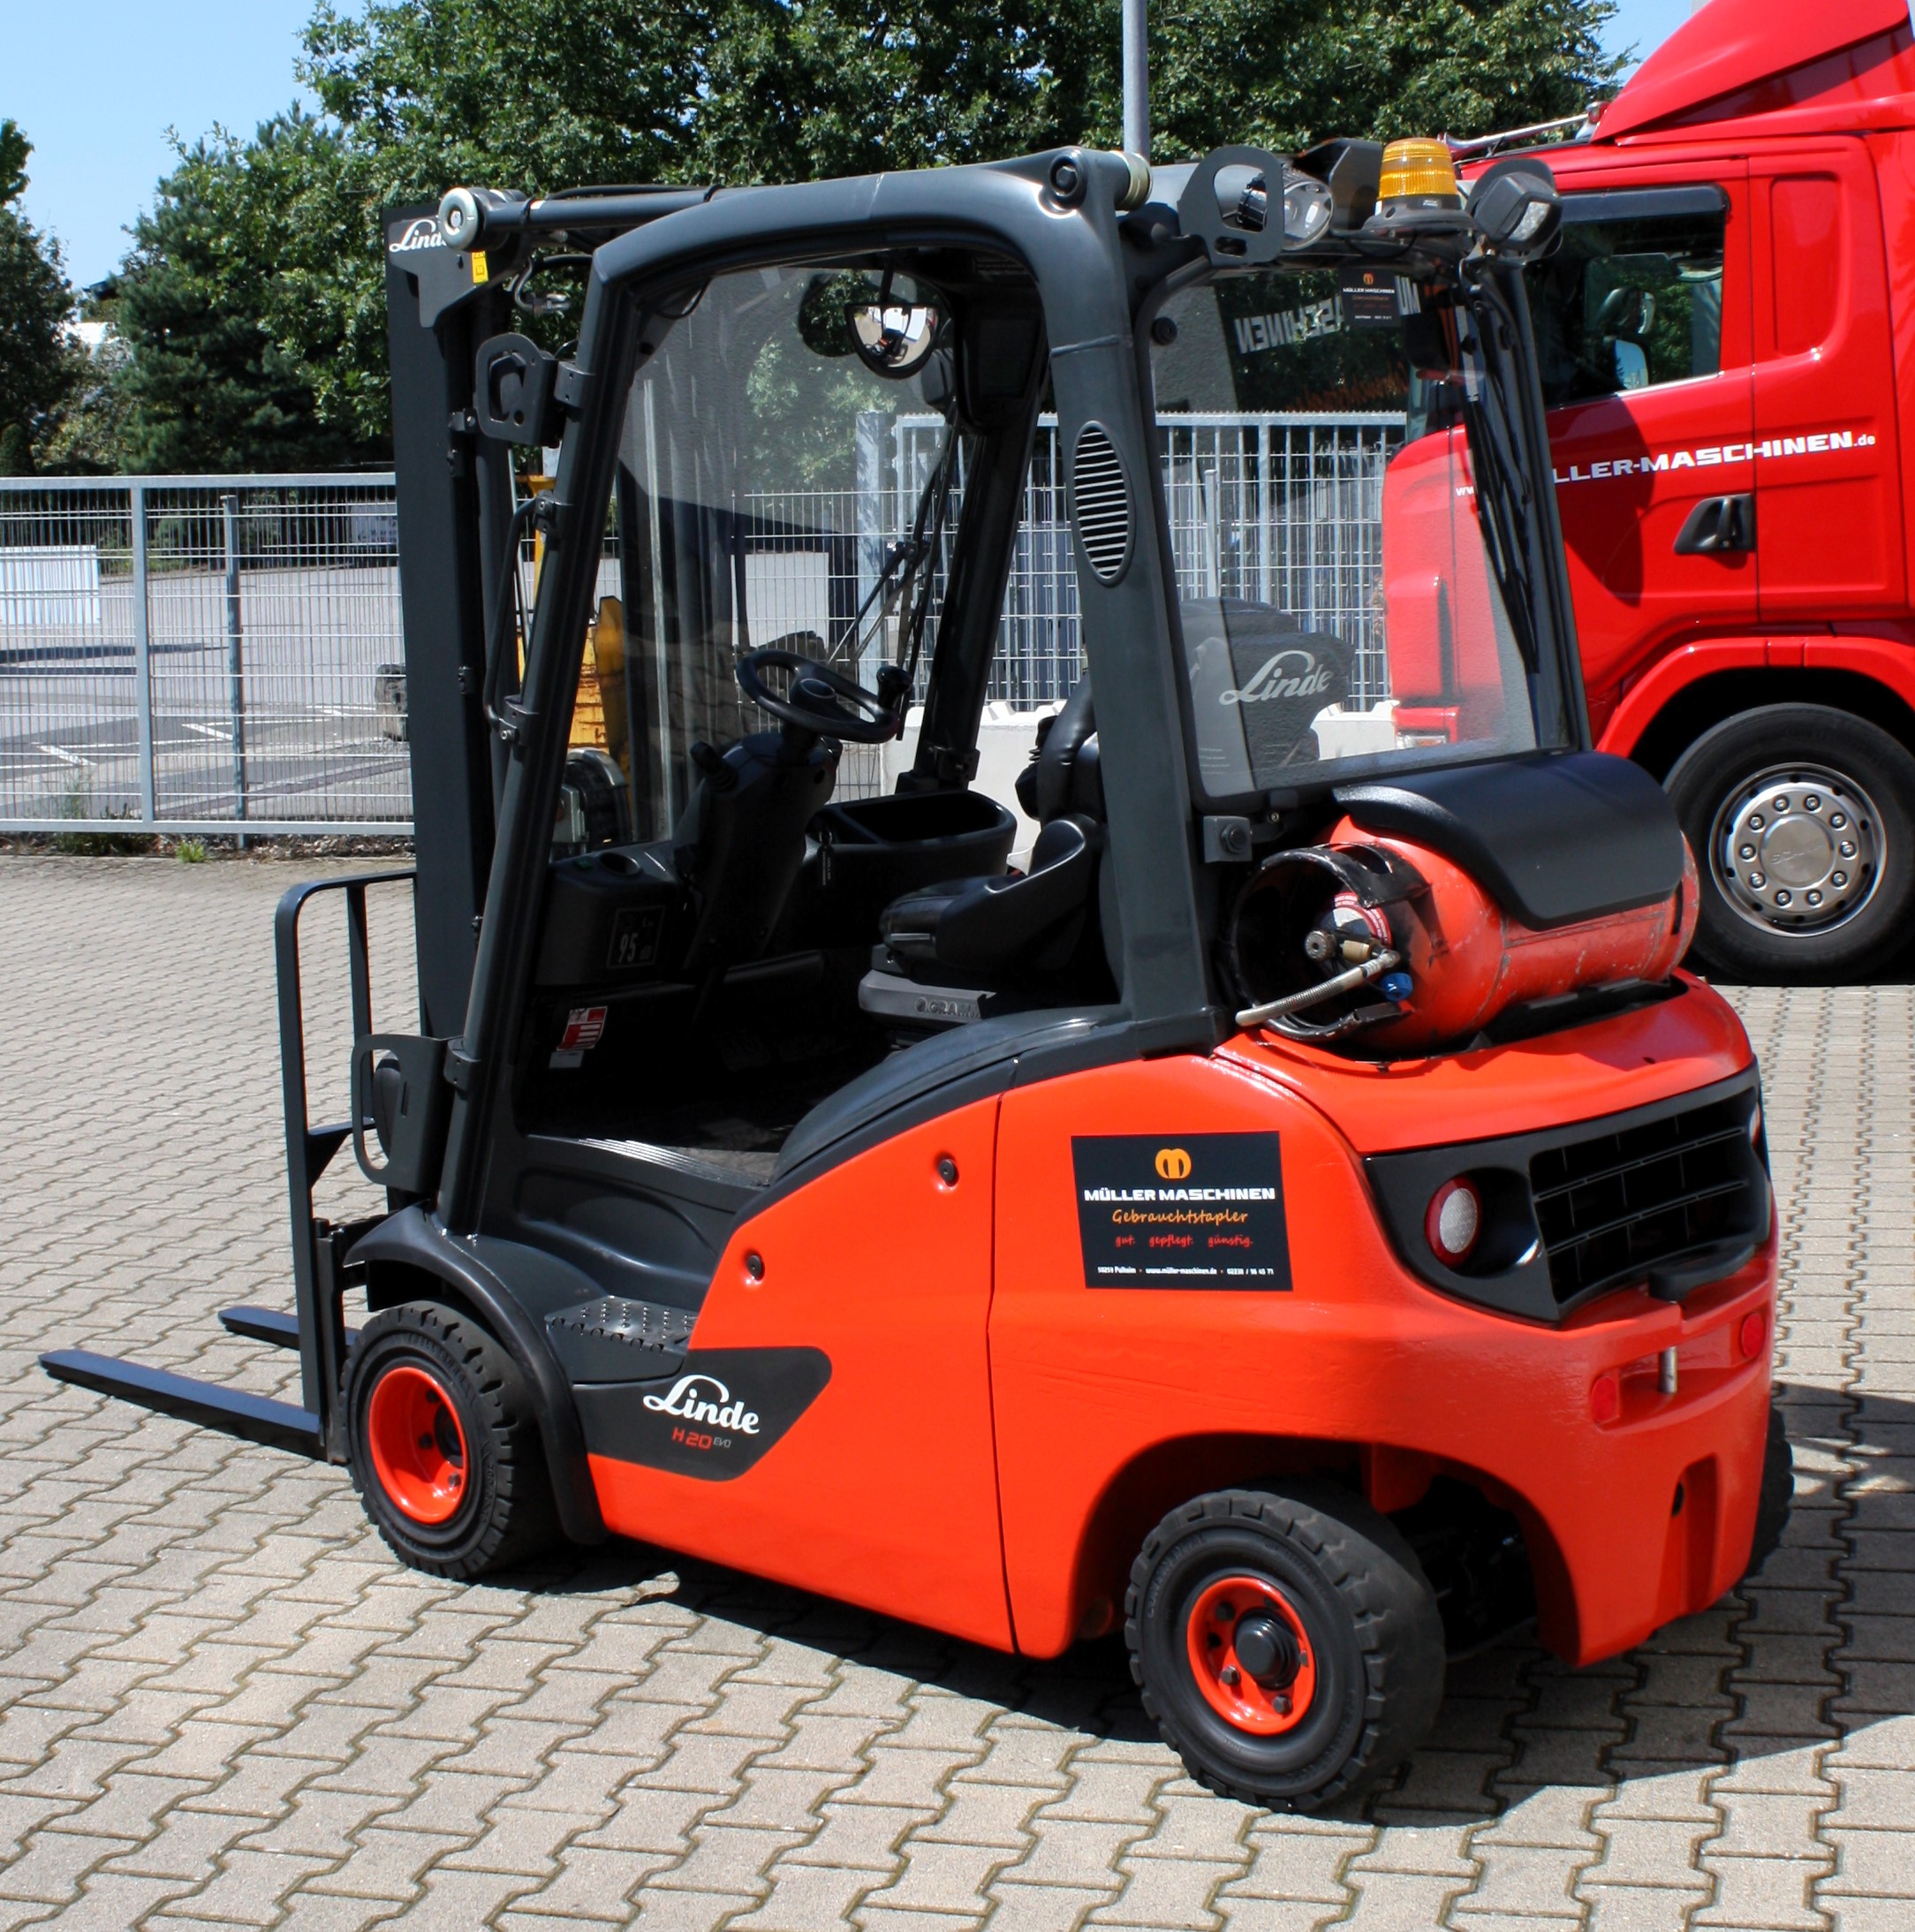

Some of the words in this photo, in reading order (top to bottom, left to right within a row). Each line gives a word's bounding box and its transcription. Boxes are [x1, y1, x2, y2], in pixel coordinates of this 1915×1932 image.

[389, 218, 447, 253] Lind
[1219, 650, 1335, 706] Linde
[619, 933, 638, 963] 95
[1084, 1187, 1155, 1201] MÜLLER
[1158, 1188, 1275, 1201] MASCHINEN
[1112, 1208, 1248, 1226] Gebrauchtstapler
[1115, 1234, 1136, 1247] gut.
[1149, 1233, 1193, 1247] gepflegt.
[1207, 1233, 1253, 1247] günstig.
[643, 1375, 760, 1434] Linde
